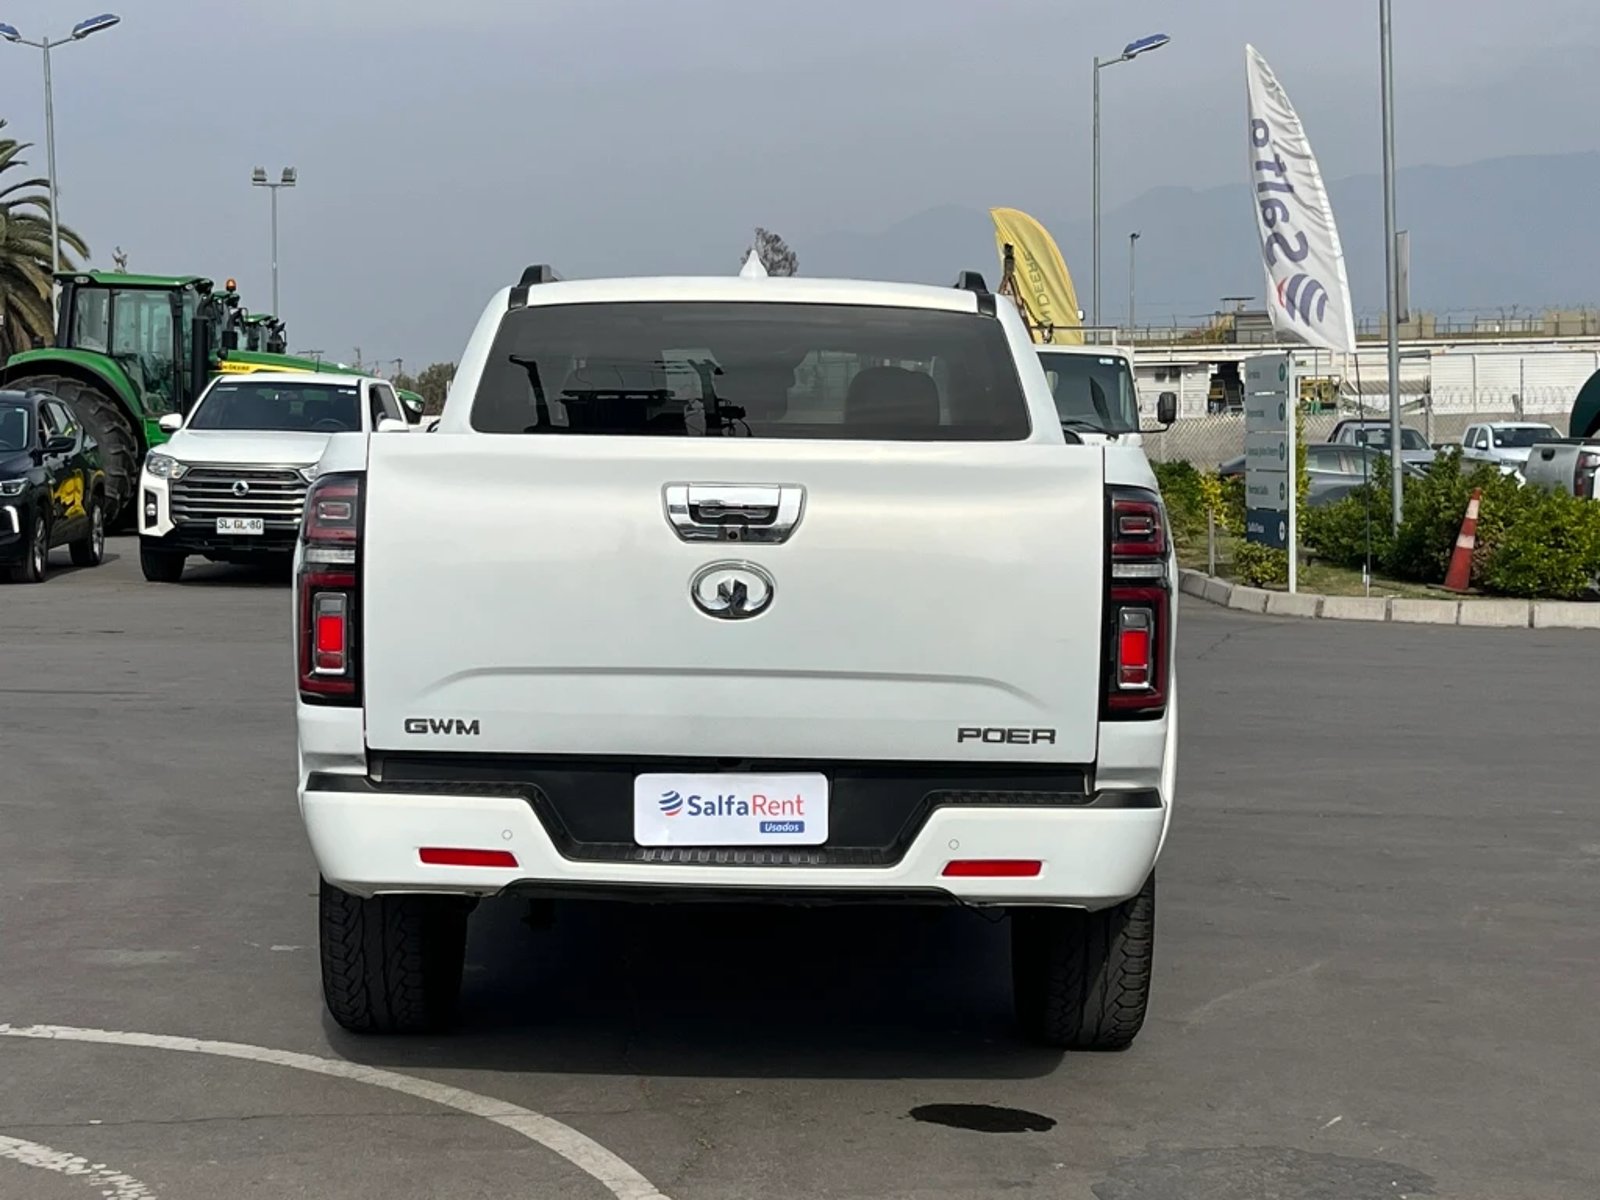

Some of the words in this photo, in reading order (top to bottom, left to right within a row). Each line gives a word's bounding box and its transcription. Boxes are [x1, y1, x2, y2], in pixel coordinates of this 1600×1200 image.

[404, 718, 480, 735] GWM
[957, 727, 1056, 744] POER
[687, 794, 805, 816] SalfaRent
[764, 822, 800, 832] Usados
